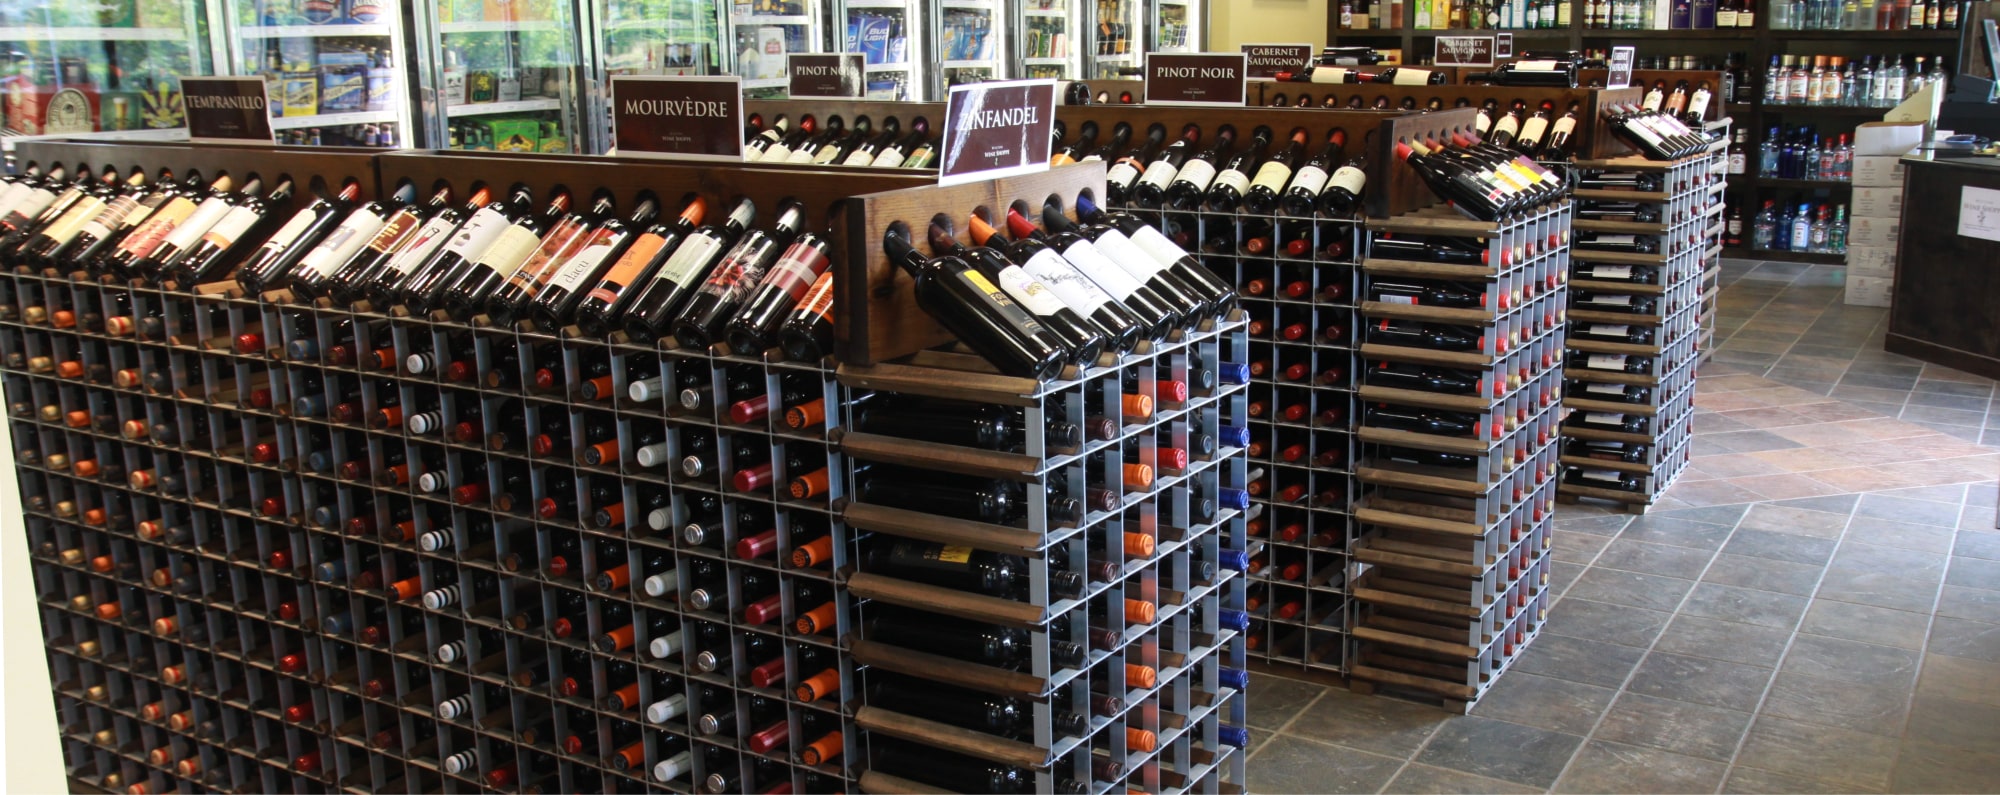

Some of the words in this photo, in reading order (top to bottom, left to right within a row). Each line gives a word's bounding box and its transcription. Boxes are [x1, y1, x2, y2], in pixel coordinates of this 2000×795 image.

[1251, 47, 1300, 56] CABERNET
[1248, 57, 1304, 66] SAUVIGNON
[796, 66, 828, 76] PINOT
[1157, 67, 1198, 78] PINOT
[1201, 67, 1235, 79] NOIR
[186, 94, 264, 111] TEMPRANILLO
[625, 95, 728, 118] MOURVÈDRE
[960, 106, 1039, 131] ZINFANDEL
